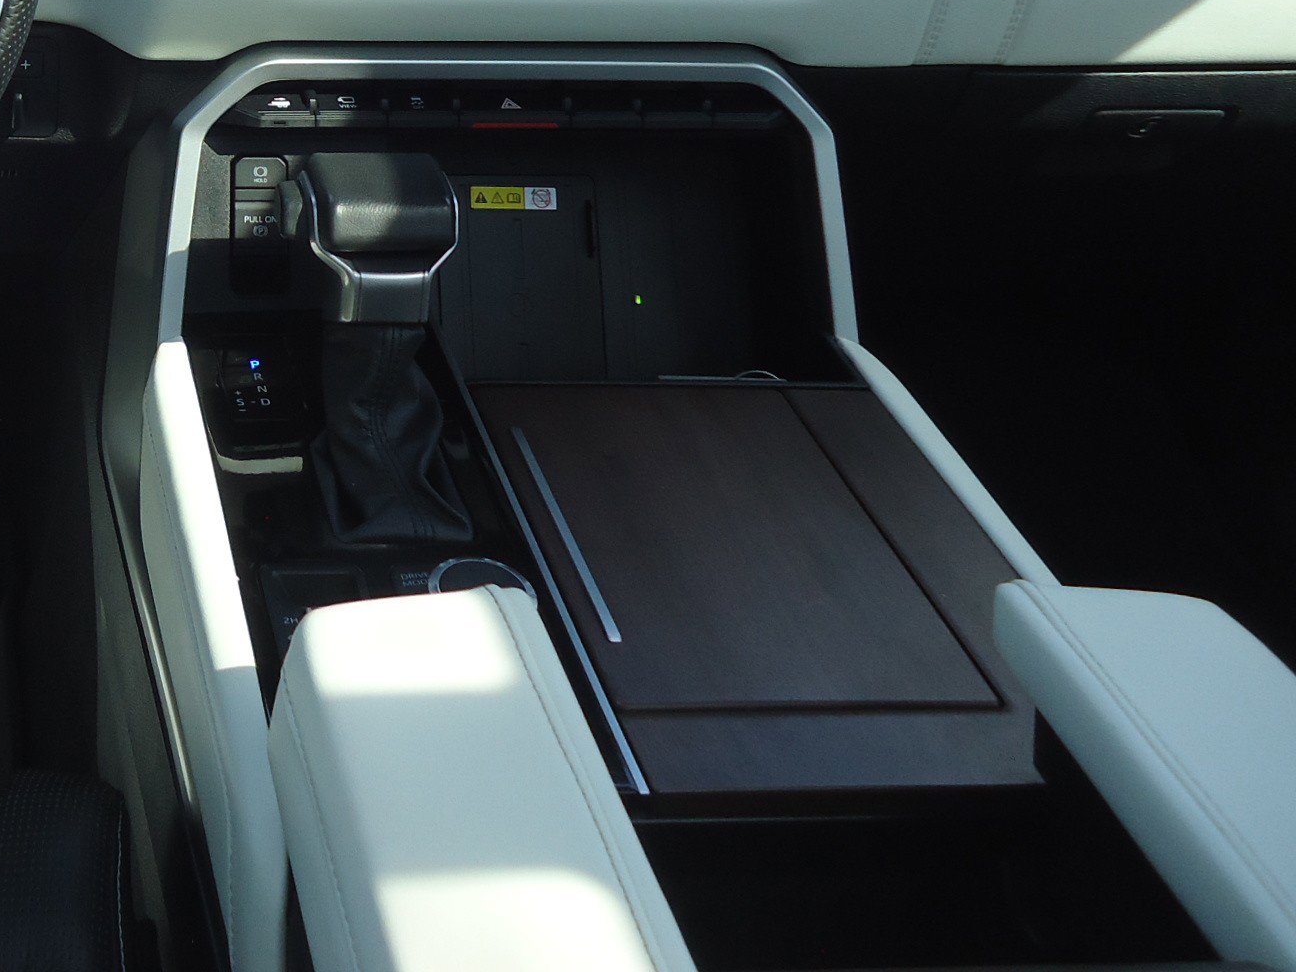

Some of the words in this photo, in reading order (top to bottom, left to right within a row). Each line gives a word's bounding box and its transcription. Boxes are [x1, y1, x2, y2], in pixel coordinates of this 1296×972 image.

[244, 215, 263, 223] PULL
[249, 360, 260, 369] P
[253, 372, 264, 381] R
[257, 385, 268, 393] N
[236, 398, 245, 406] S
[260, 398, 271, 406] D
